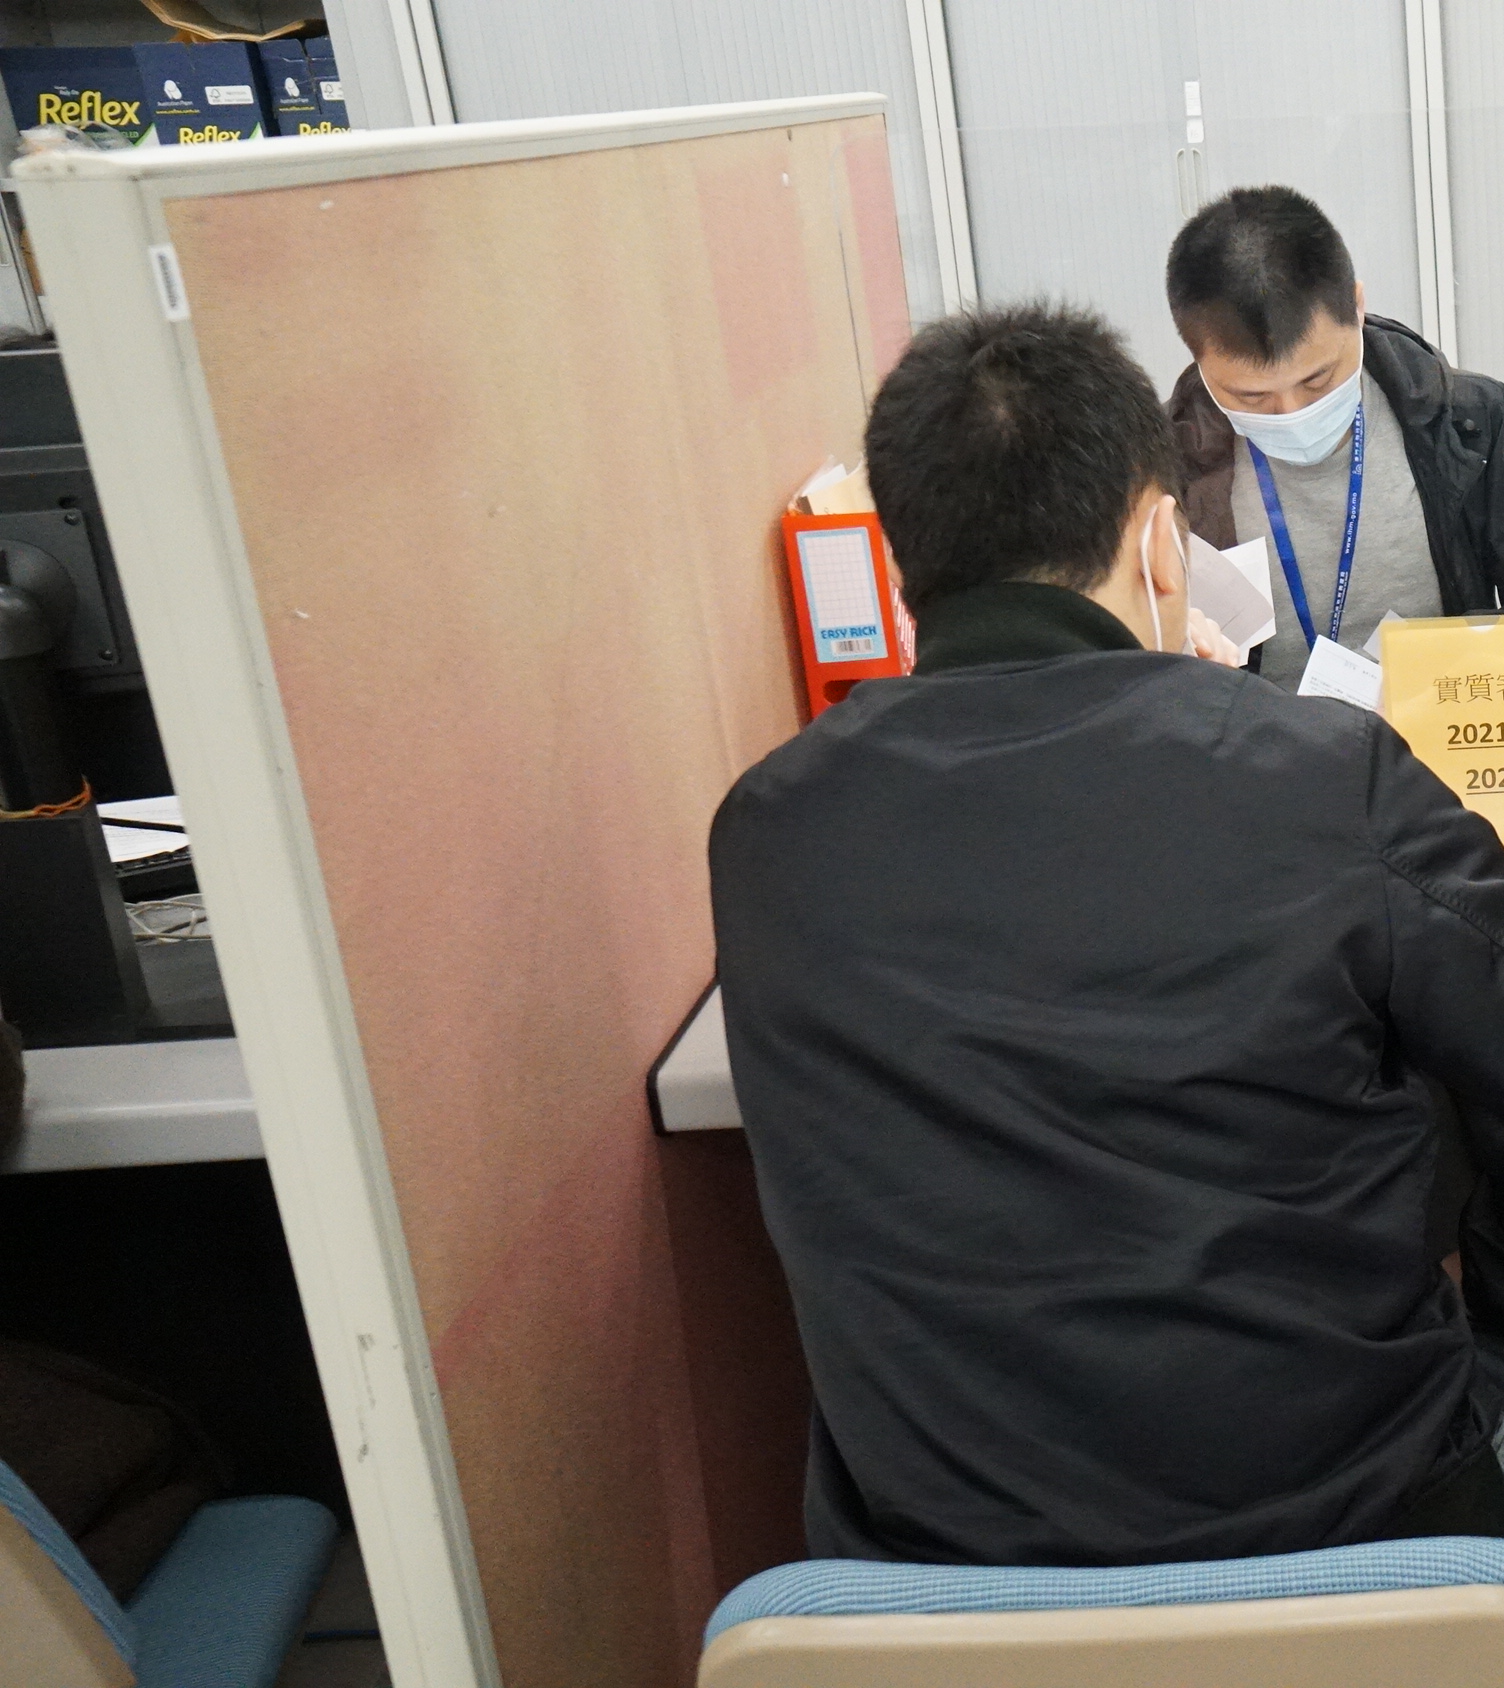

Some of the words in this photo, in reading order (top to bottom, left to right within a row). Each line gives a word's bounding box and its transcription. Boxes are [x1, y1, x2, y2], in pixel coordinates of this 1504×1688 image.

[38, 91, 140, 129] Reflex
[179, 125, 241, 145] Reflex
[1345, 492, 1358, 554] www.ihm.gov.mo
[821, 628, 847, 639] EASY
[850, 625, 877, 637] RICH
